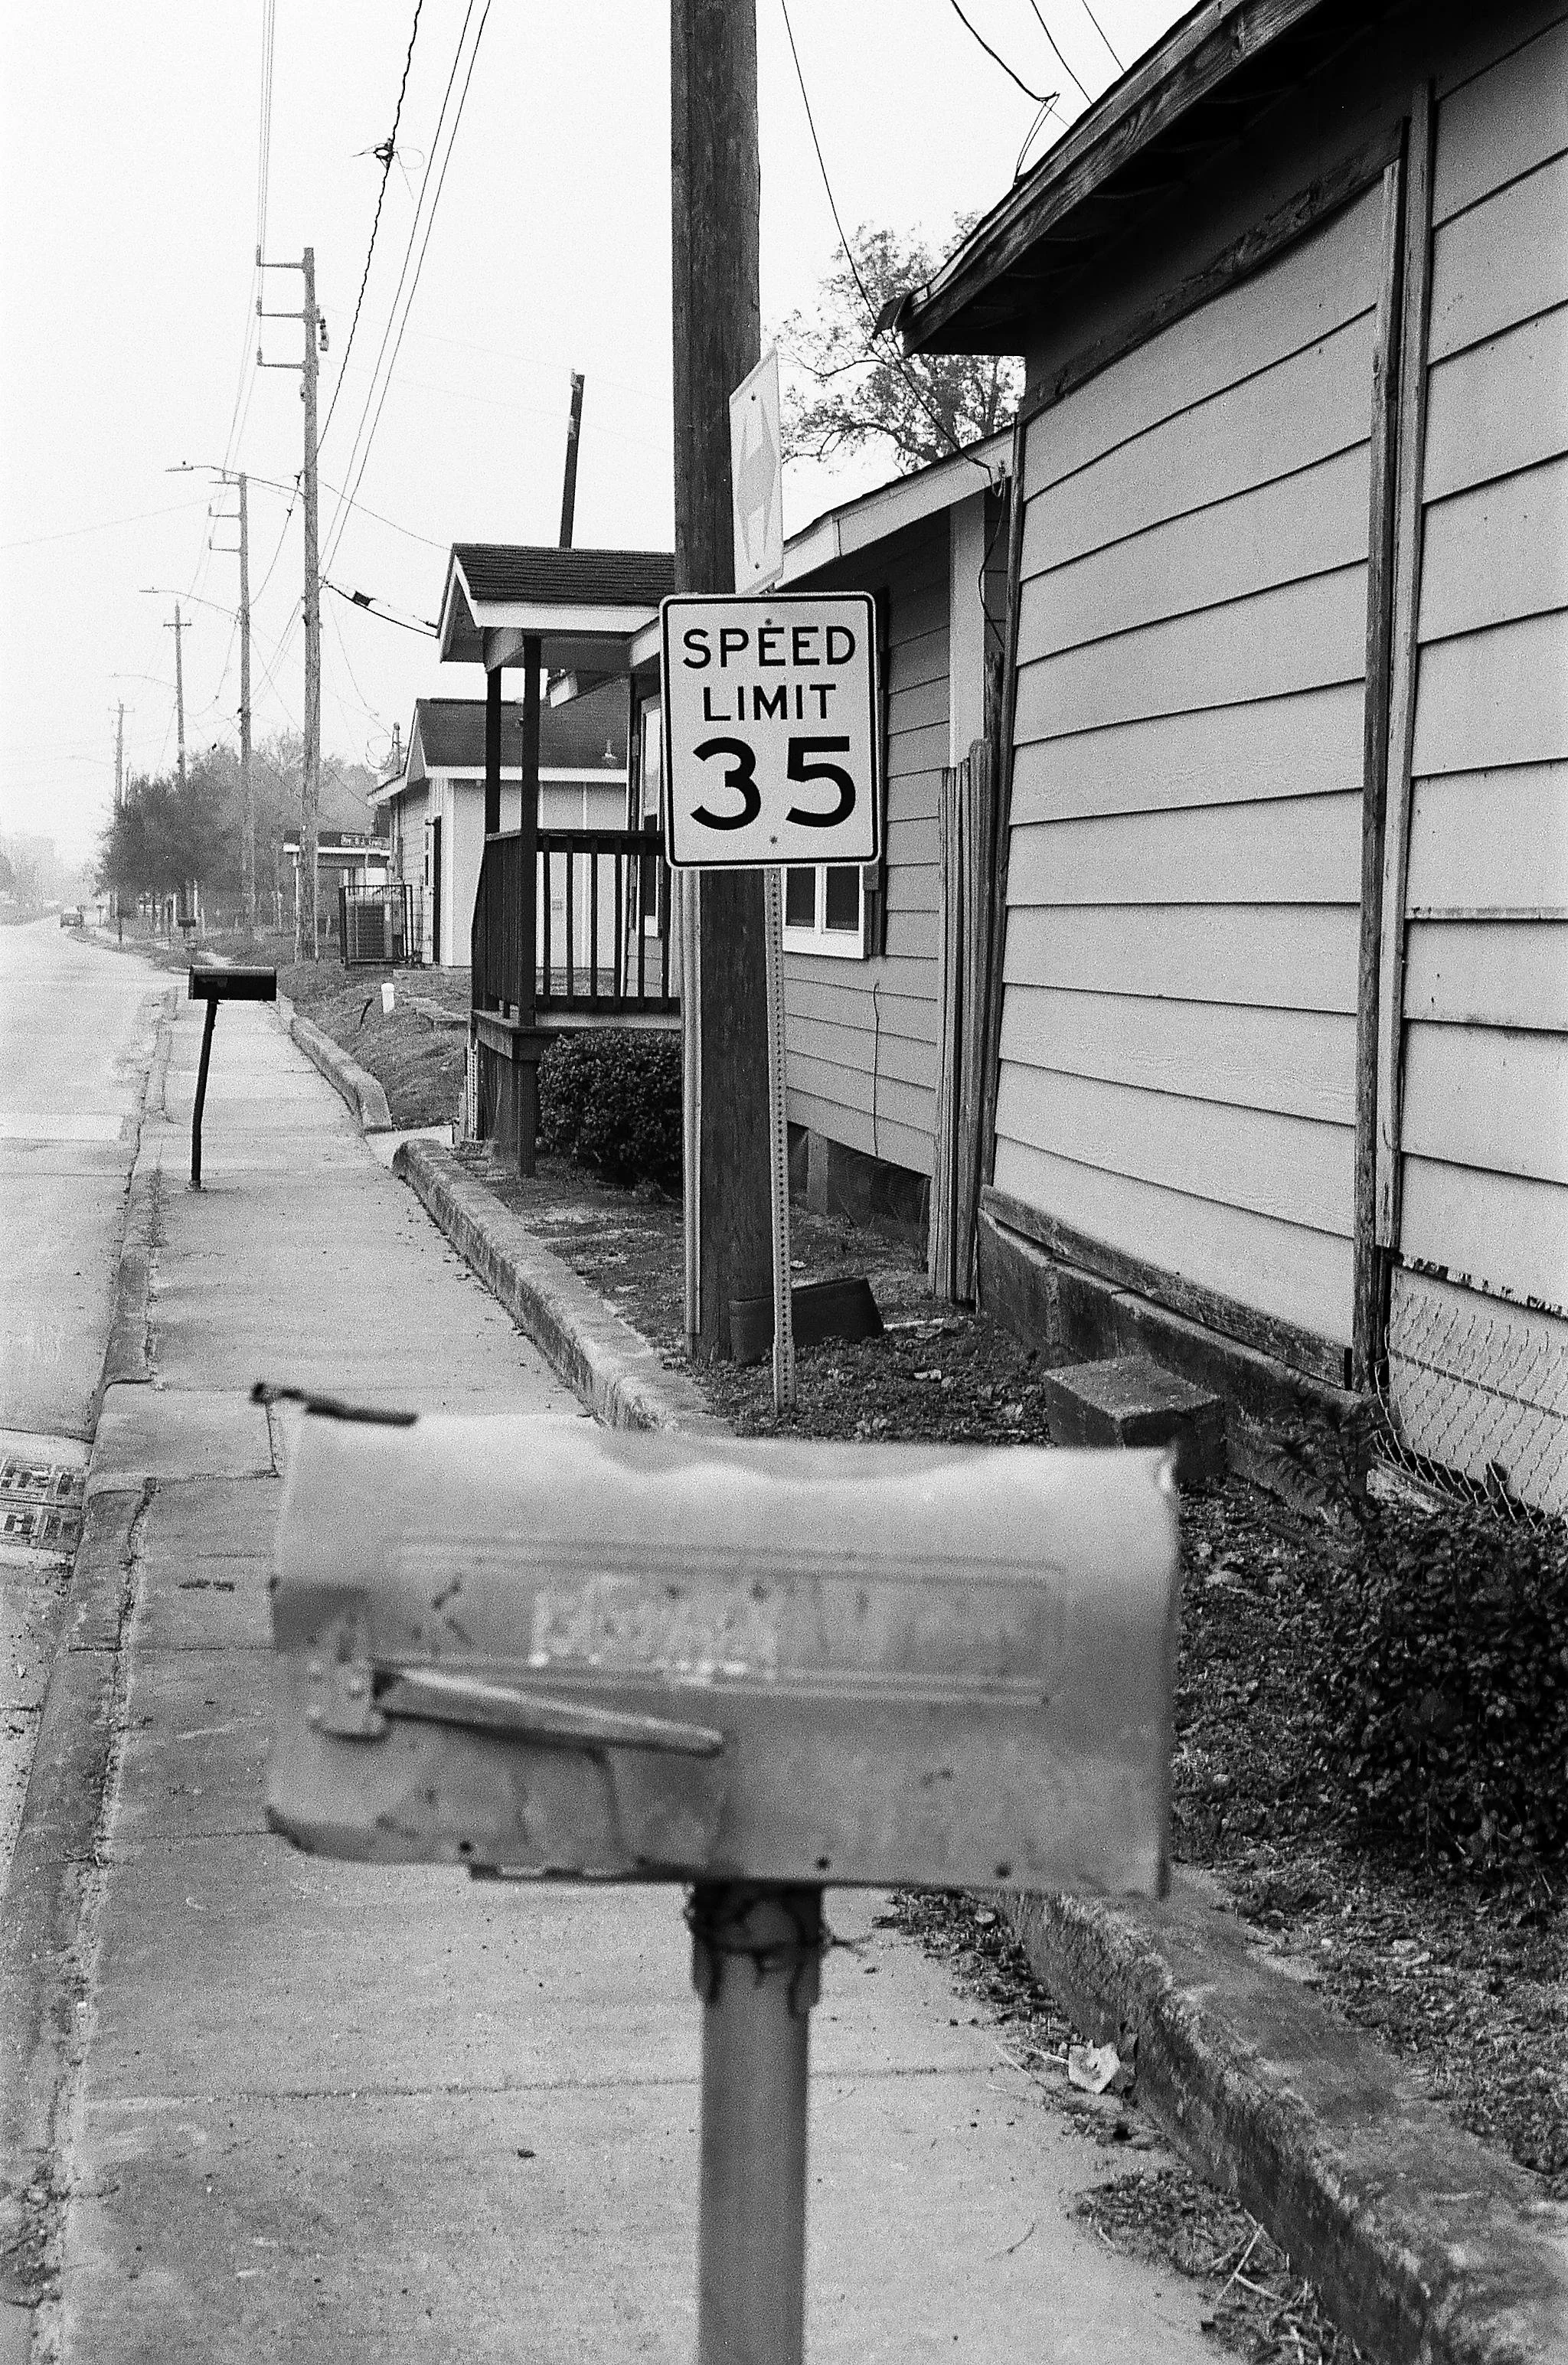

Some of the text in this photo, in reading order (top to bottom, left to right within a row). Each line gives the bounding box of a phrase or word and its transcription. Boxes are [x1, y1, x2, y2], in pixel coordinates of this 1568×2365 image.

[683, 626, 856, 668] SPEED
[703, 684, 836, 721] LIMIT
[690, 737, 856, 831] 35
